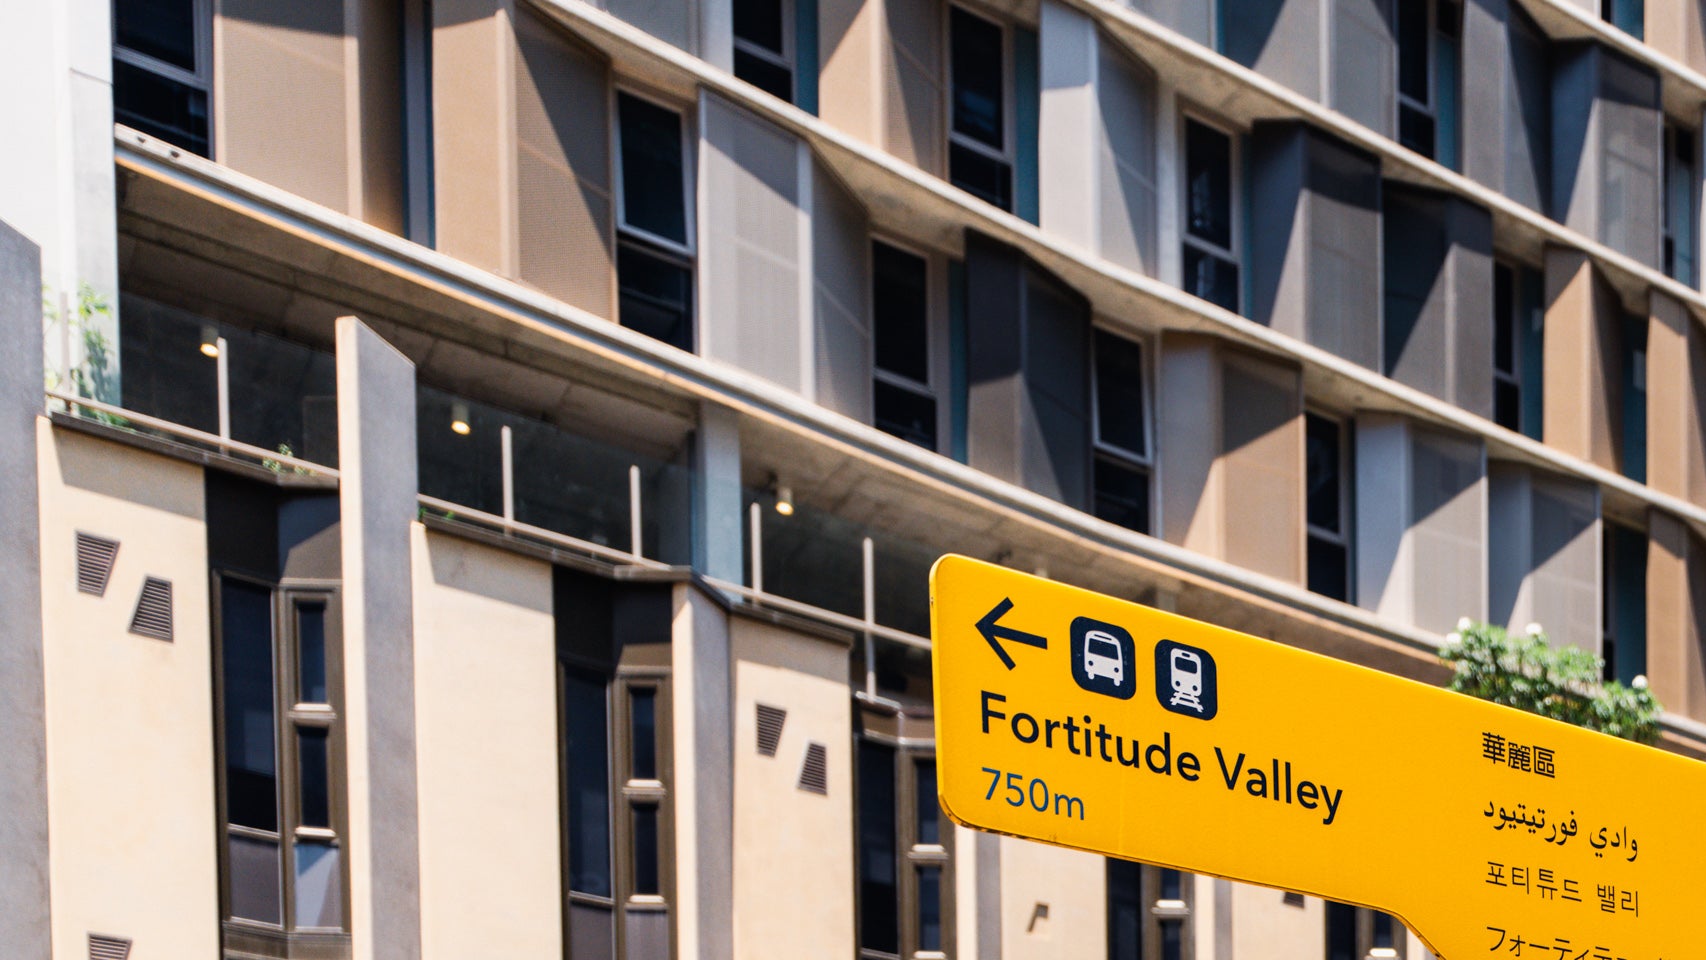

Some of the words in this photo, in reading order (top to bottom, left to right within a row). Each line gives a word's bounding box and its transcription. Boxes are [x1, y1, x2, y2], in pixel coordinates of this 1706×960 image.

[981, 690, 1200, 781] Fortitude
[1214, 747, 1343, 825] Valley
[1482, 732, 1555, 778] 華麗區
[982, 767, 1084, 820] 750m
[1214, 747, 1343, 825] Valley
[1484, 802, 1577, 845] فورتيتيود
[1590, 827, 1637, 862] وادي
[1486, 862, 1582, 902] 포티튜드
[1597, 884, 1638, 917] 밸리
